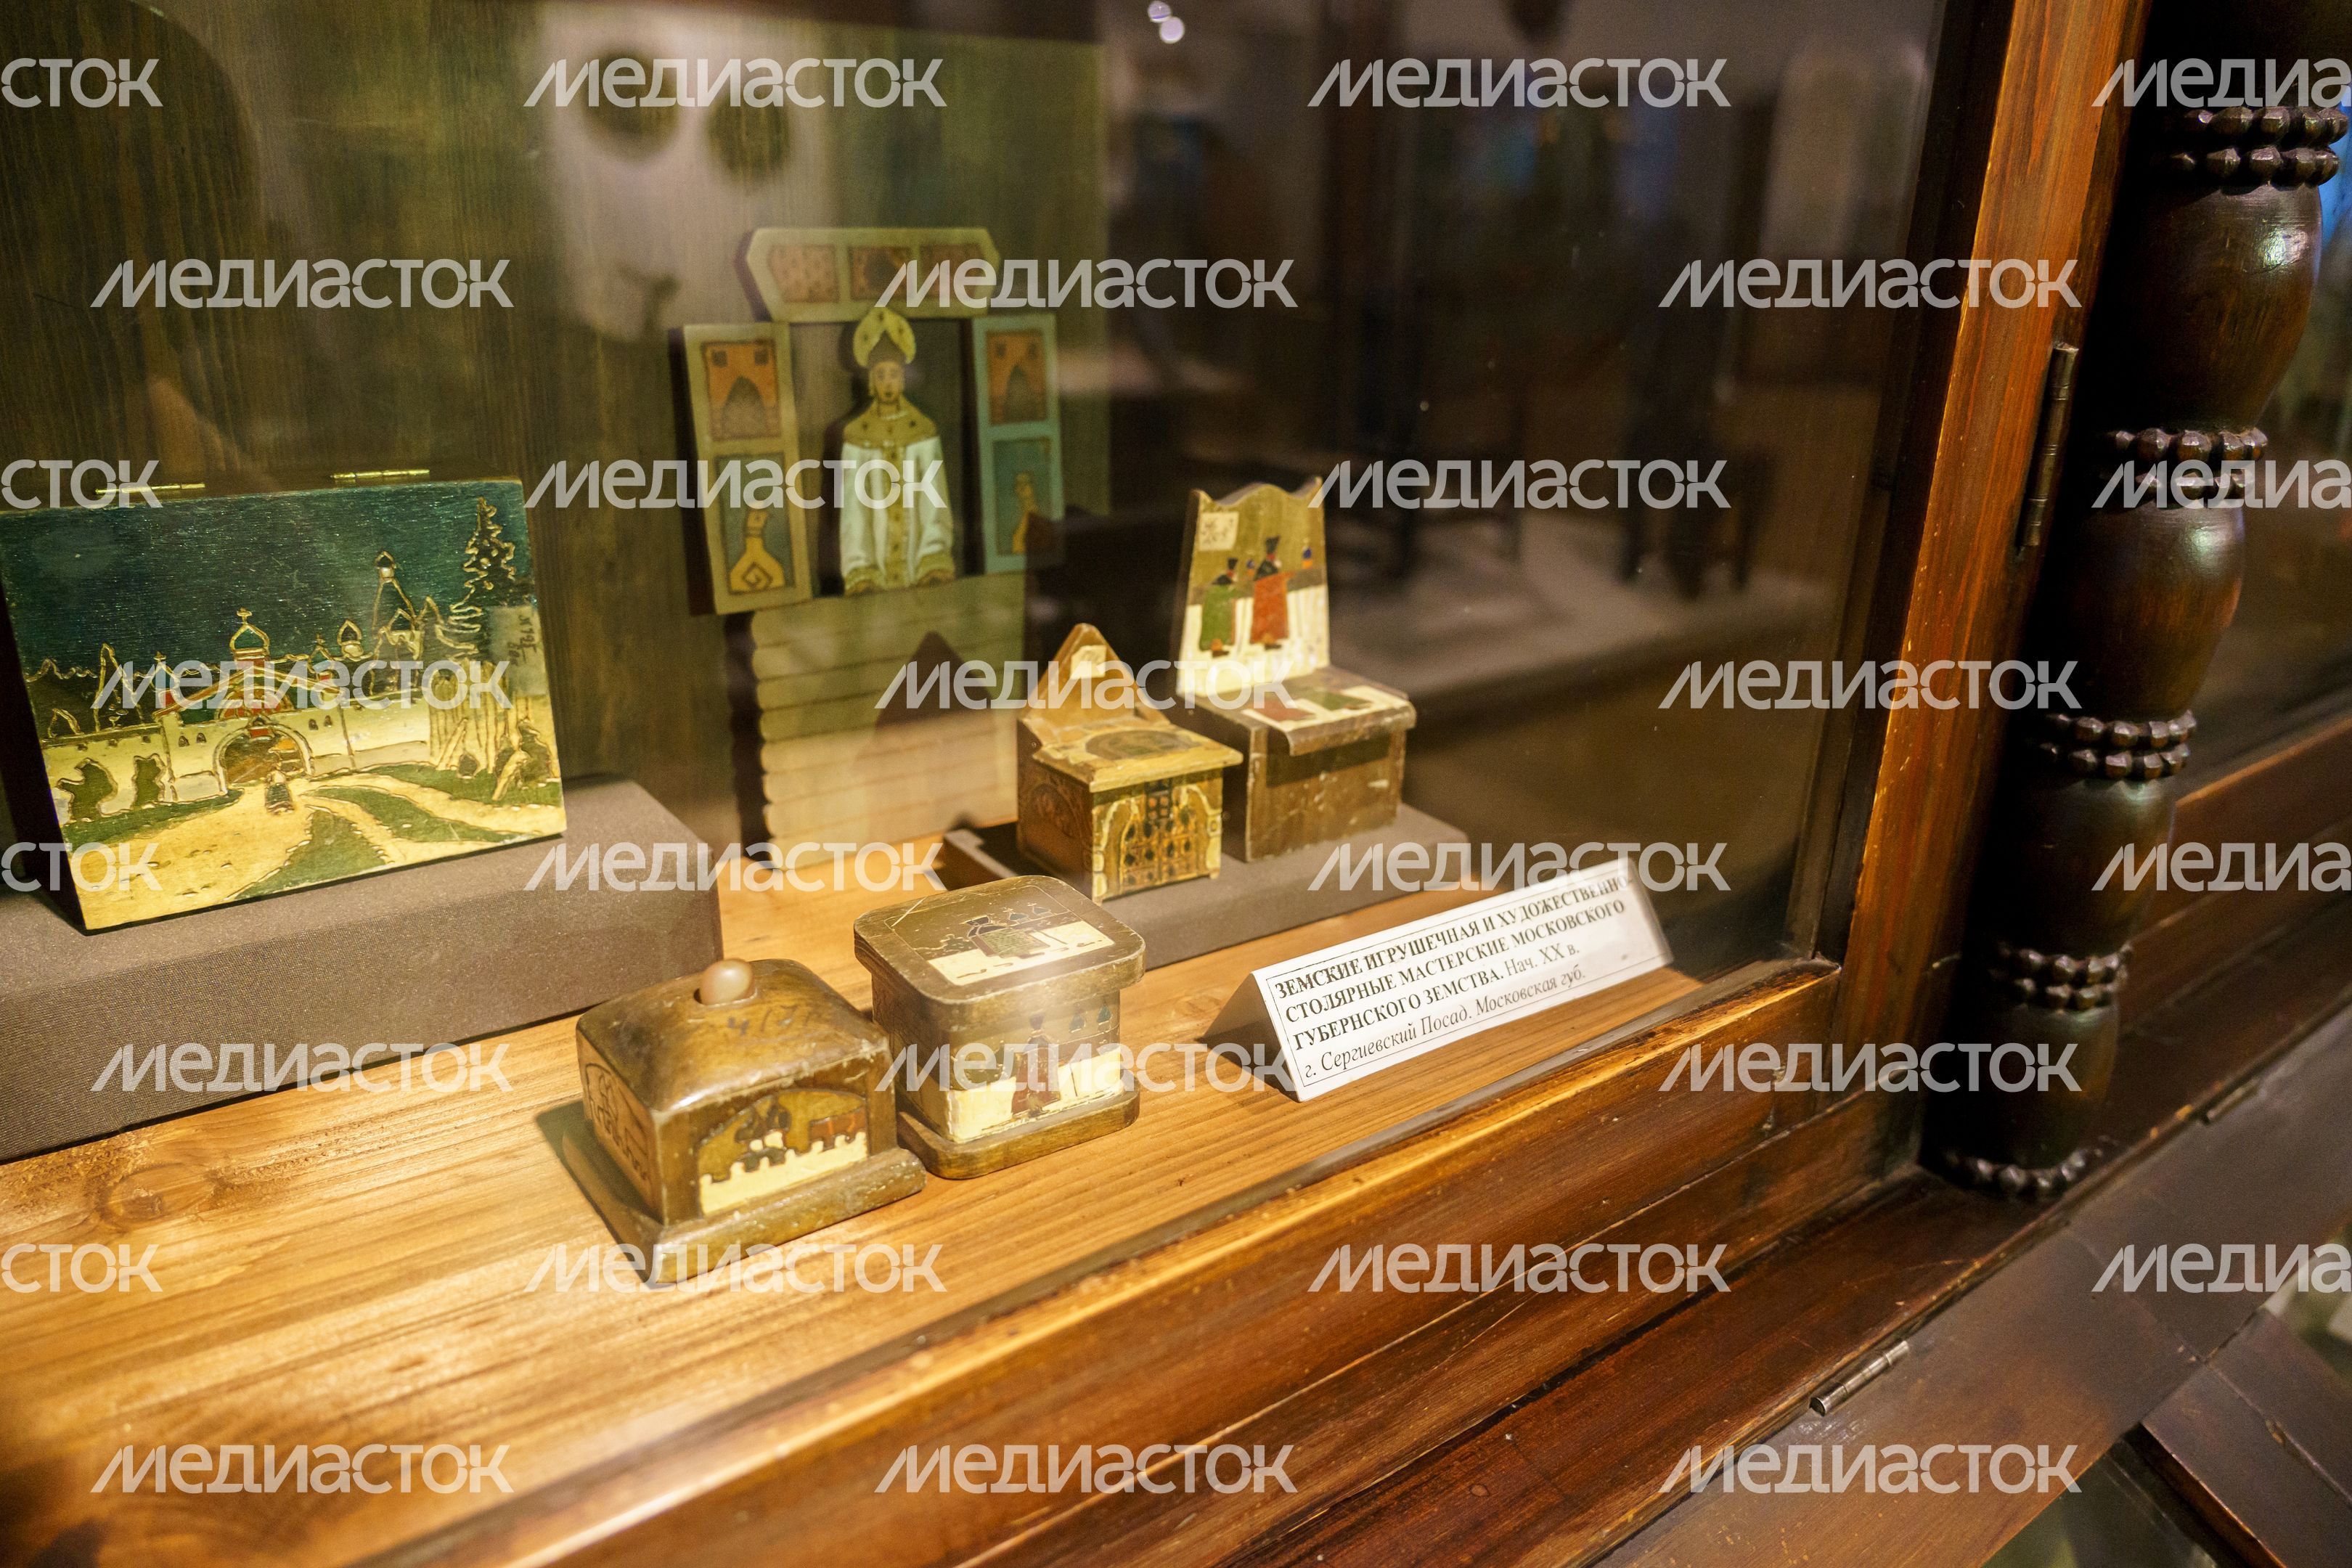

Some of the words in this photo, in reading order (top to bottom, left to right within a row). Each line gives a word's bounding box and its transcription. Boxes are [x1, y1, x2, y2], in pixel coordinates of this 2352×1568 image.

[1275, 958, 1362, 1000] ЗЕМСКИЕ
[1363, 920, 1481, 971] ИГРУШЕЧНАЯ
[1482, 917, 1496, 932] И
[1286, 973, 1397, 1023] СТОЛЯРНЫЕ
[1397, 936, 1510, 986] МАСТЕРСКИЕ
[1511, 899, 1625, 948] МОСКОВСКОГО
[1293, 993, 1421, 1051] ГУБЕРНСКОГО
[1423, 968, 1504, 1005] ЗЕМСТВА.
[1504, 955, 1538, 976] Нач.
[1564, 943, 1580, 956] в.
[1304, 1064, 1317, 1078] г.
[1321, 1021, 1418, 1070] Сергиевский
[1420, 1004, 1472, 1036] Посад.
[1475, 975, 1558, 1016] Московская
[1560, 963, 1586, 989] губ.
